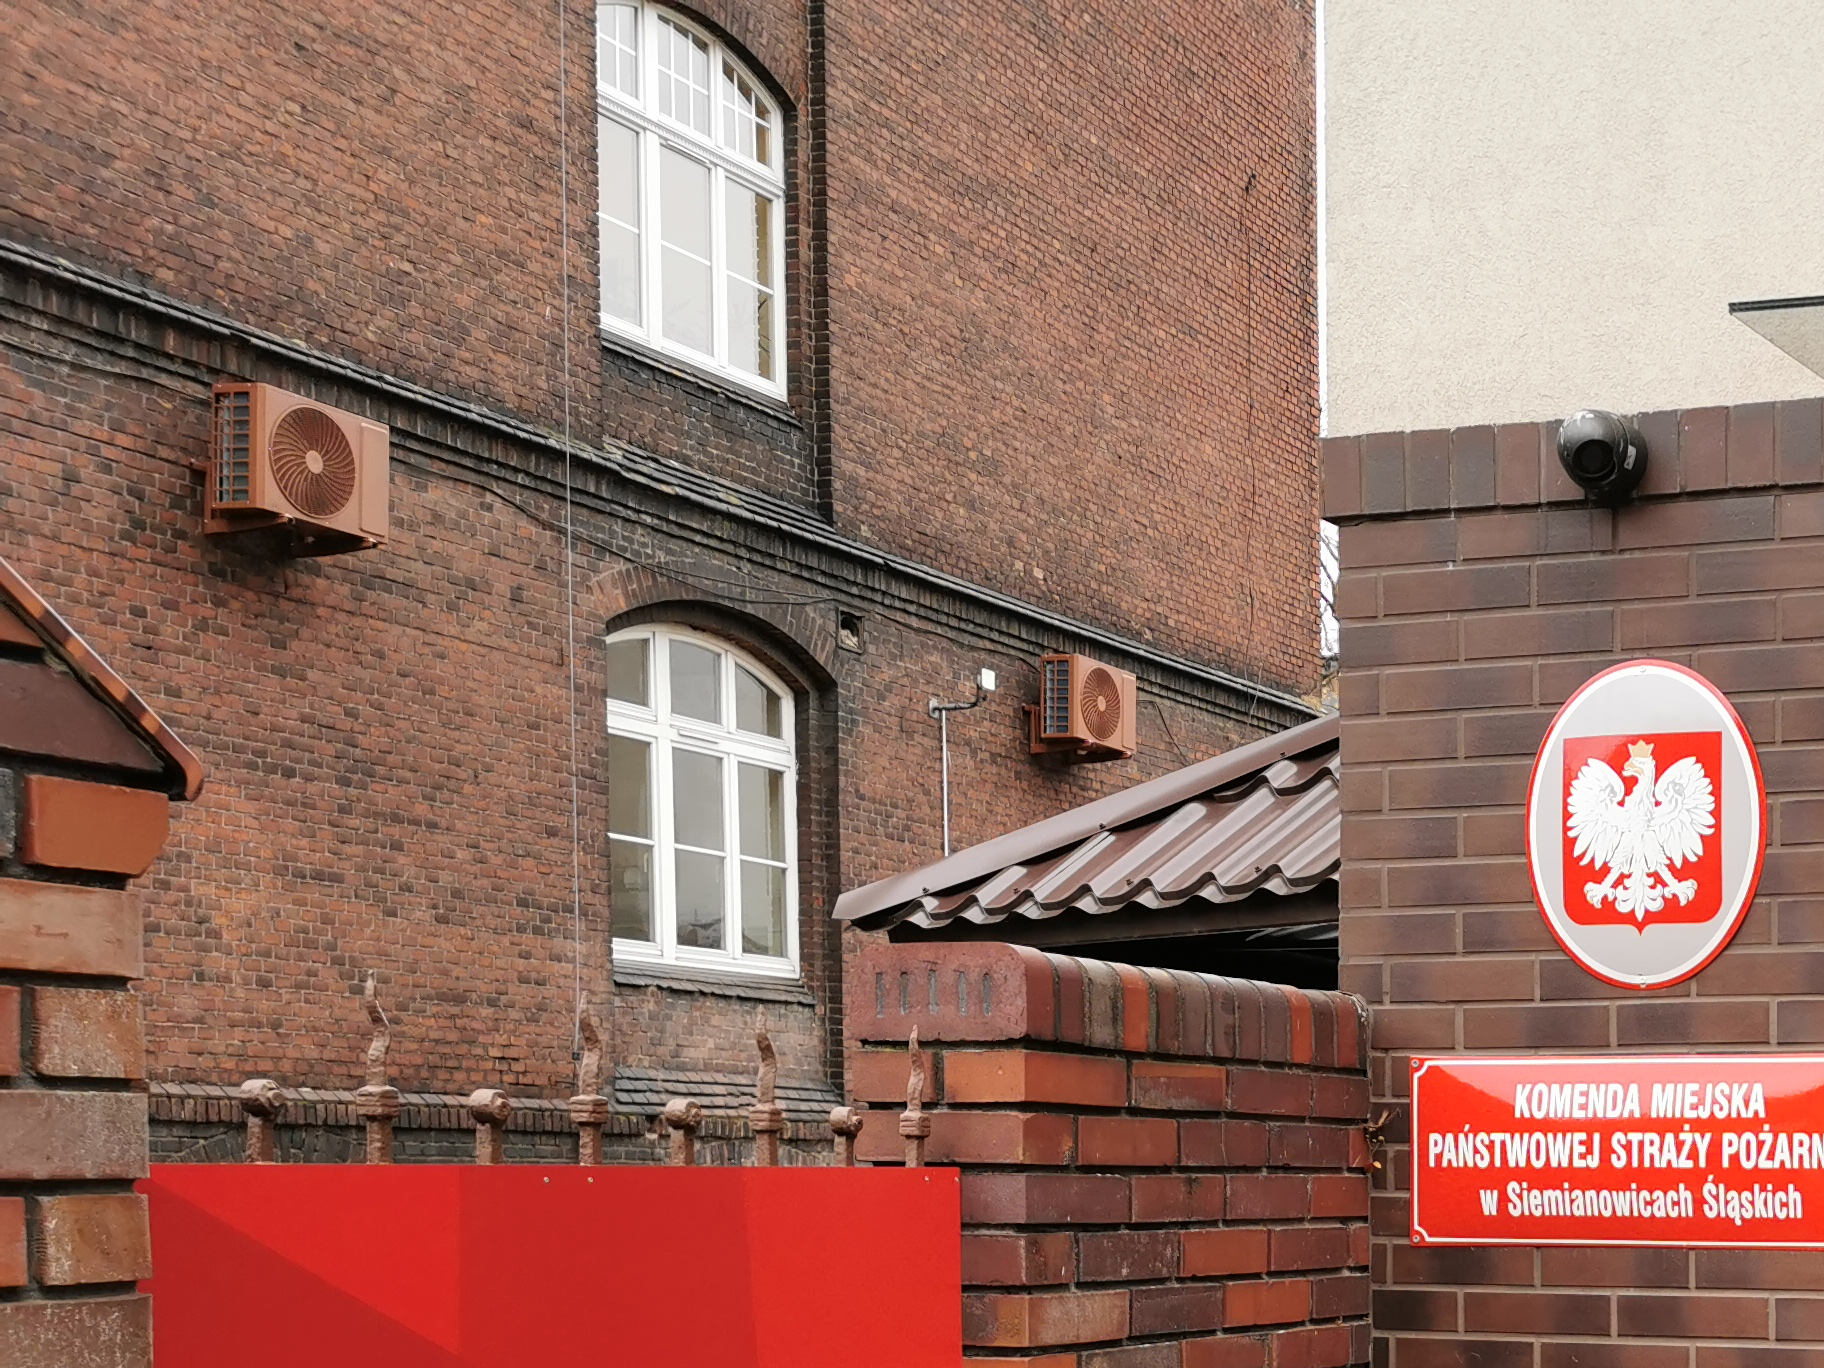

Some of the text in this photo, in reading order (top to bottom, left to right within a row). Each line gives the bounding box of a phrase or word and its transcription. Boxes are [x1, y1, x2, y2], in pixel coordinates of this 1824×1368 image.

[1514, 1082, 1766, 1119] KOMENDA MIEJSKA
[1428, 1123, 1601, 1169] PAŃSTWOWEJ
[1611, 1124, 1711, 1169] STRAŻY
[1479, 1175, 1803, 1226] w Siemianowicach Śląskich
